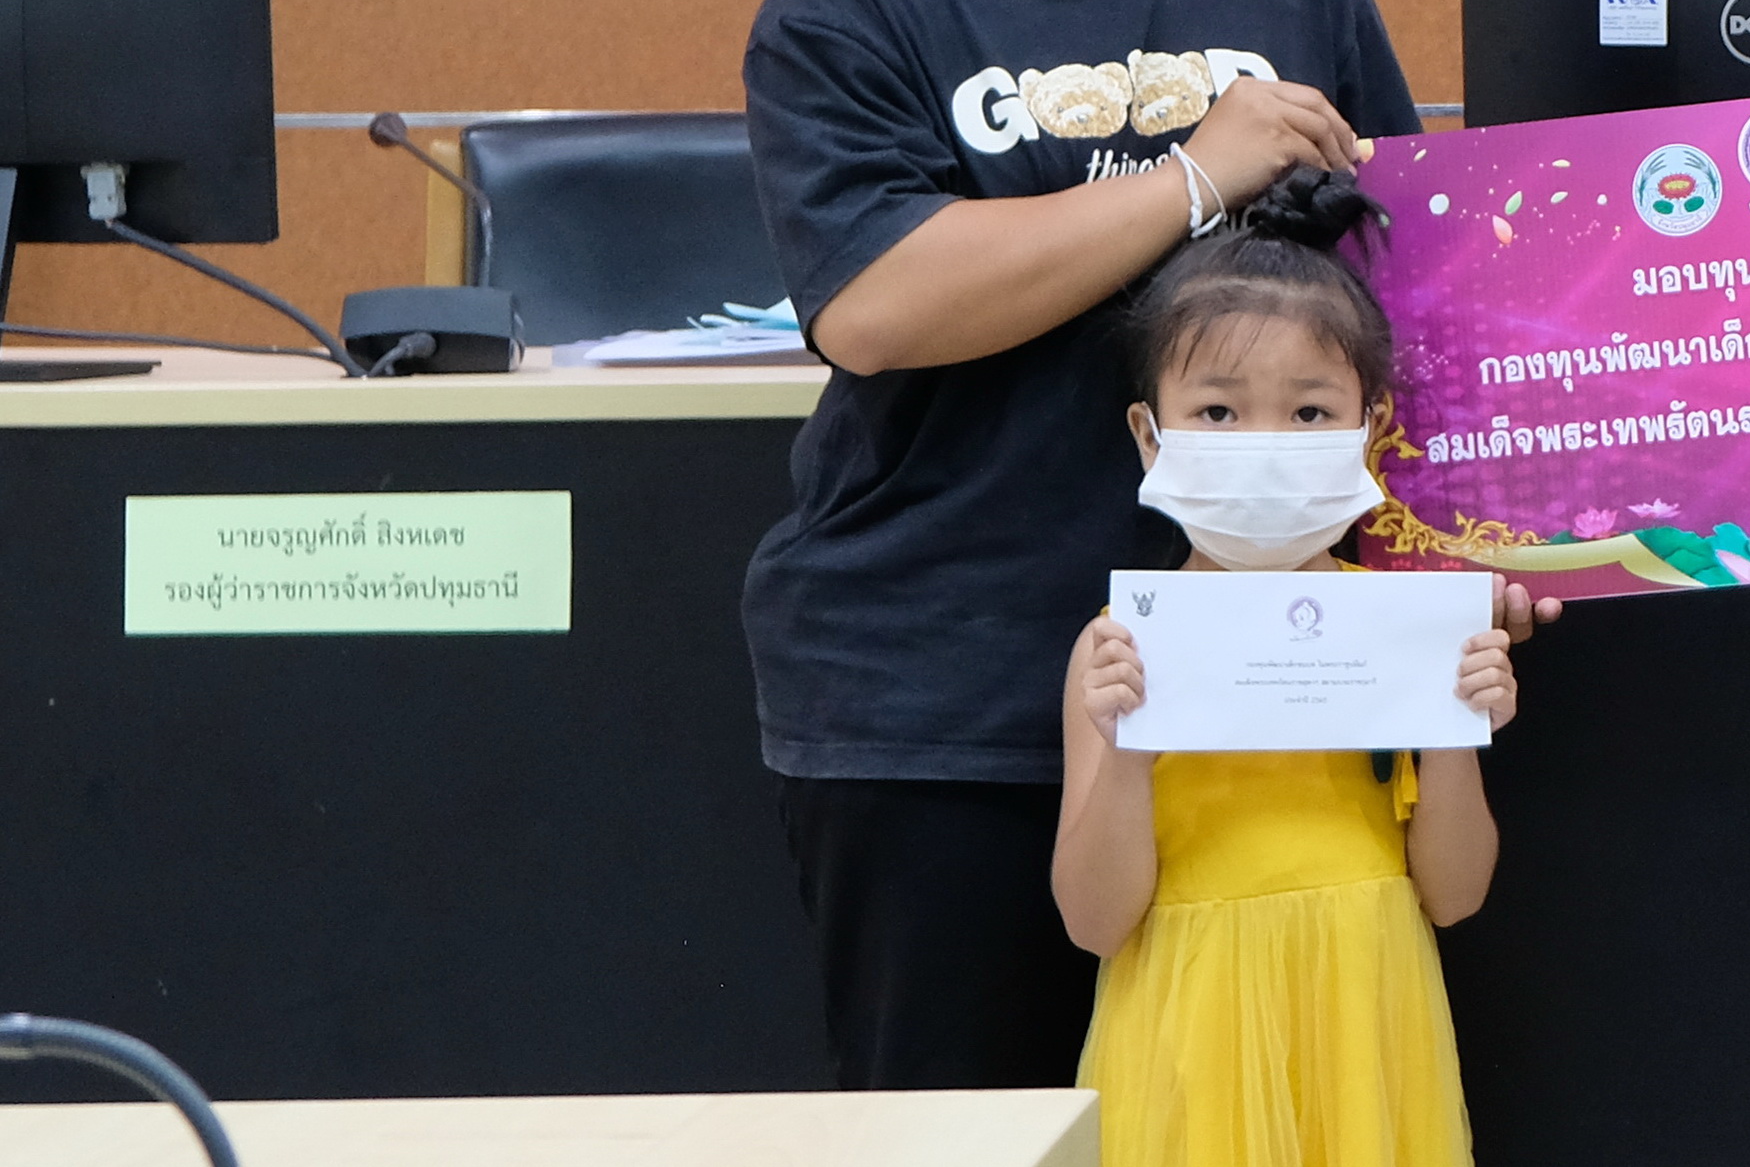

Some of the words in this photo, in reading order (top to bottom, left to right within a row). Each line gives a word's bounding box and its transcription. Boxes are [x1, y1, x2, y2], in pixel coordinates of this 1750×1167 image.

[217, 511, 368, 557] นายจรูญศักดิ์
[377, 518, 466, 547] สิงหเดช
[164, 569, 520, 611] รองผู้ว่าราชการจังหวัดปทุมธานี
